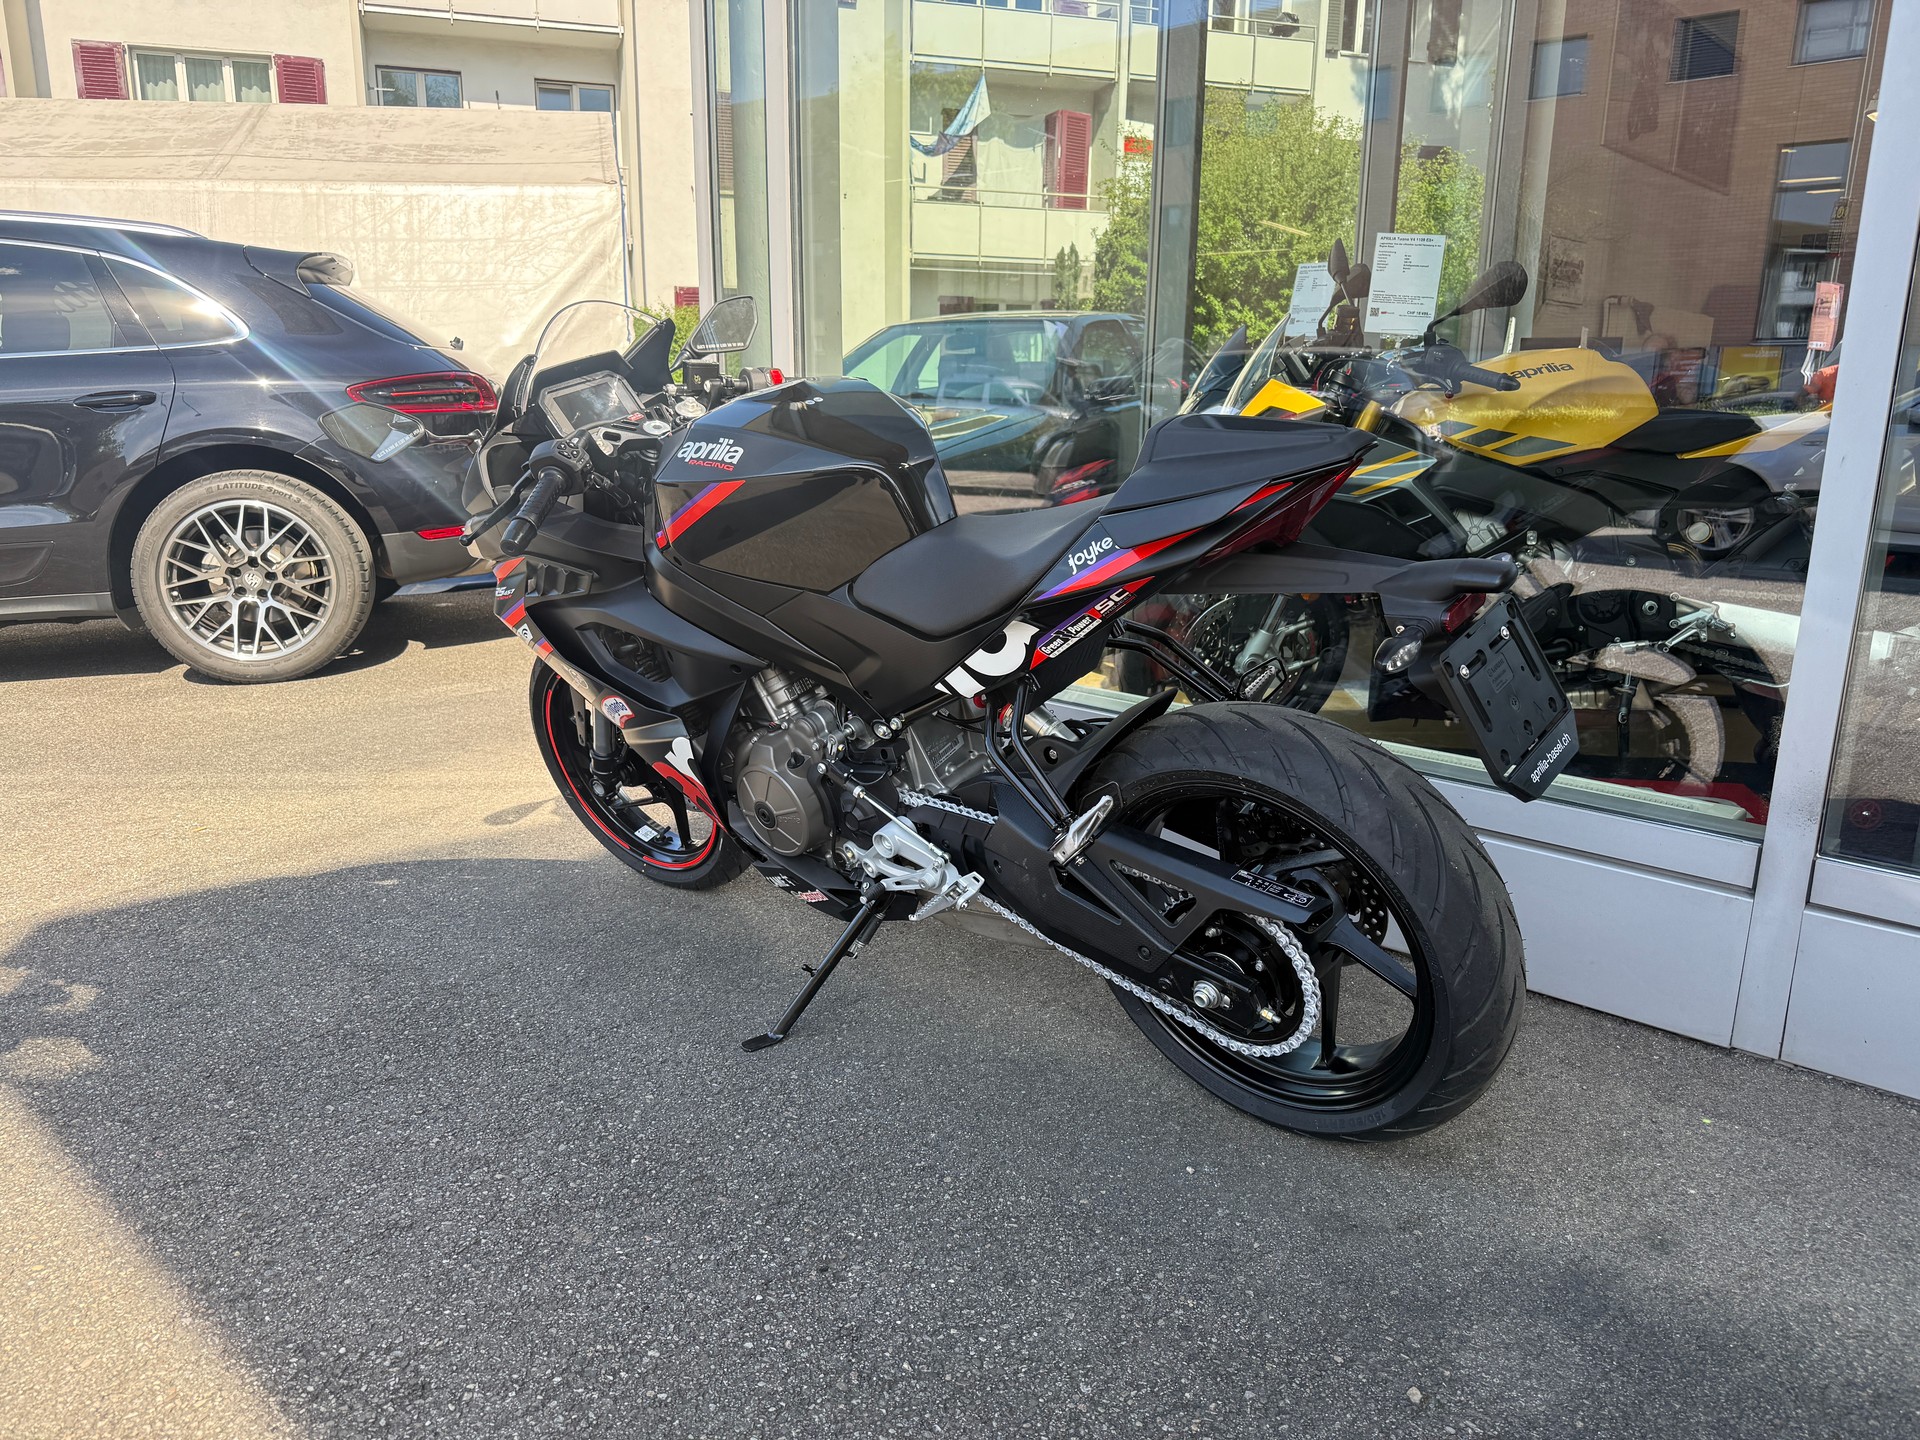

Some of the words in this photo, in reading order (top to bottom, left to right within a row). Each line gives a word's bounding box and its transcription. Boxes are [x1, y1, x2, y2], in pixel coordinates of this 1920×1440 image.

[1510, 362, 1574, 378] aprilia
[677, 437, 744, 464] aprilia
[688, 459, 735, 472] RACING
[216, 482, 264, 491] LATITUDE
[266, 486, 293, 500] Sport
[1094, 588, 1130, 614] SC
[1041, 637, 1065, 655] Green
[1067, 616, 1093, 635] Power
[1530, 732, 1572, 783] aprilia-basel.ch
